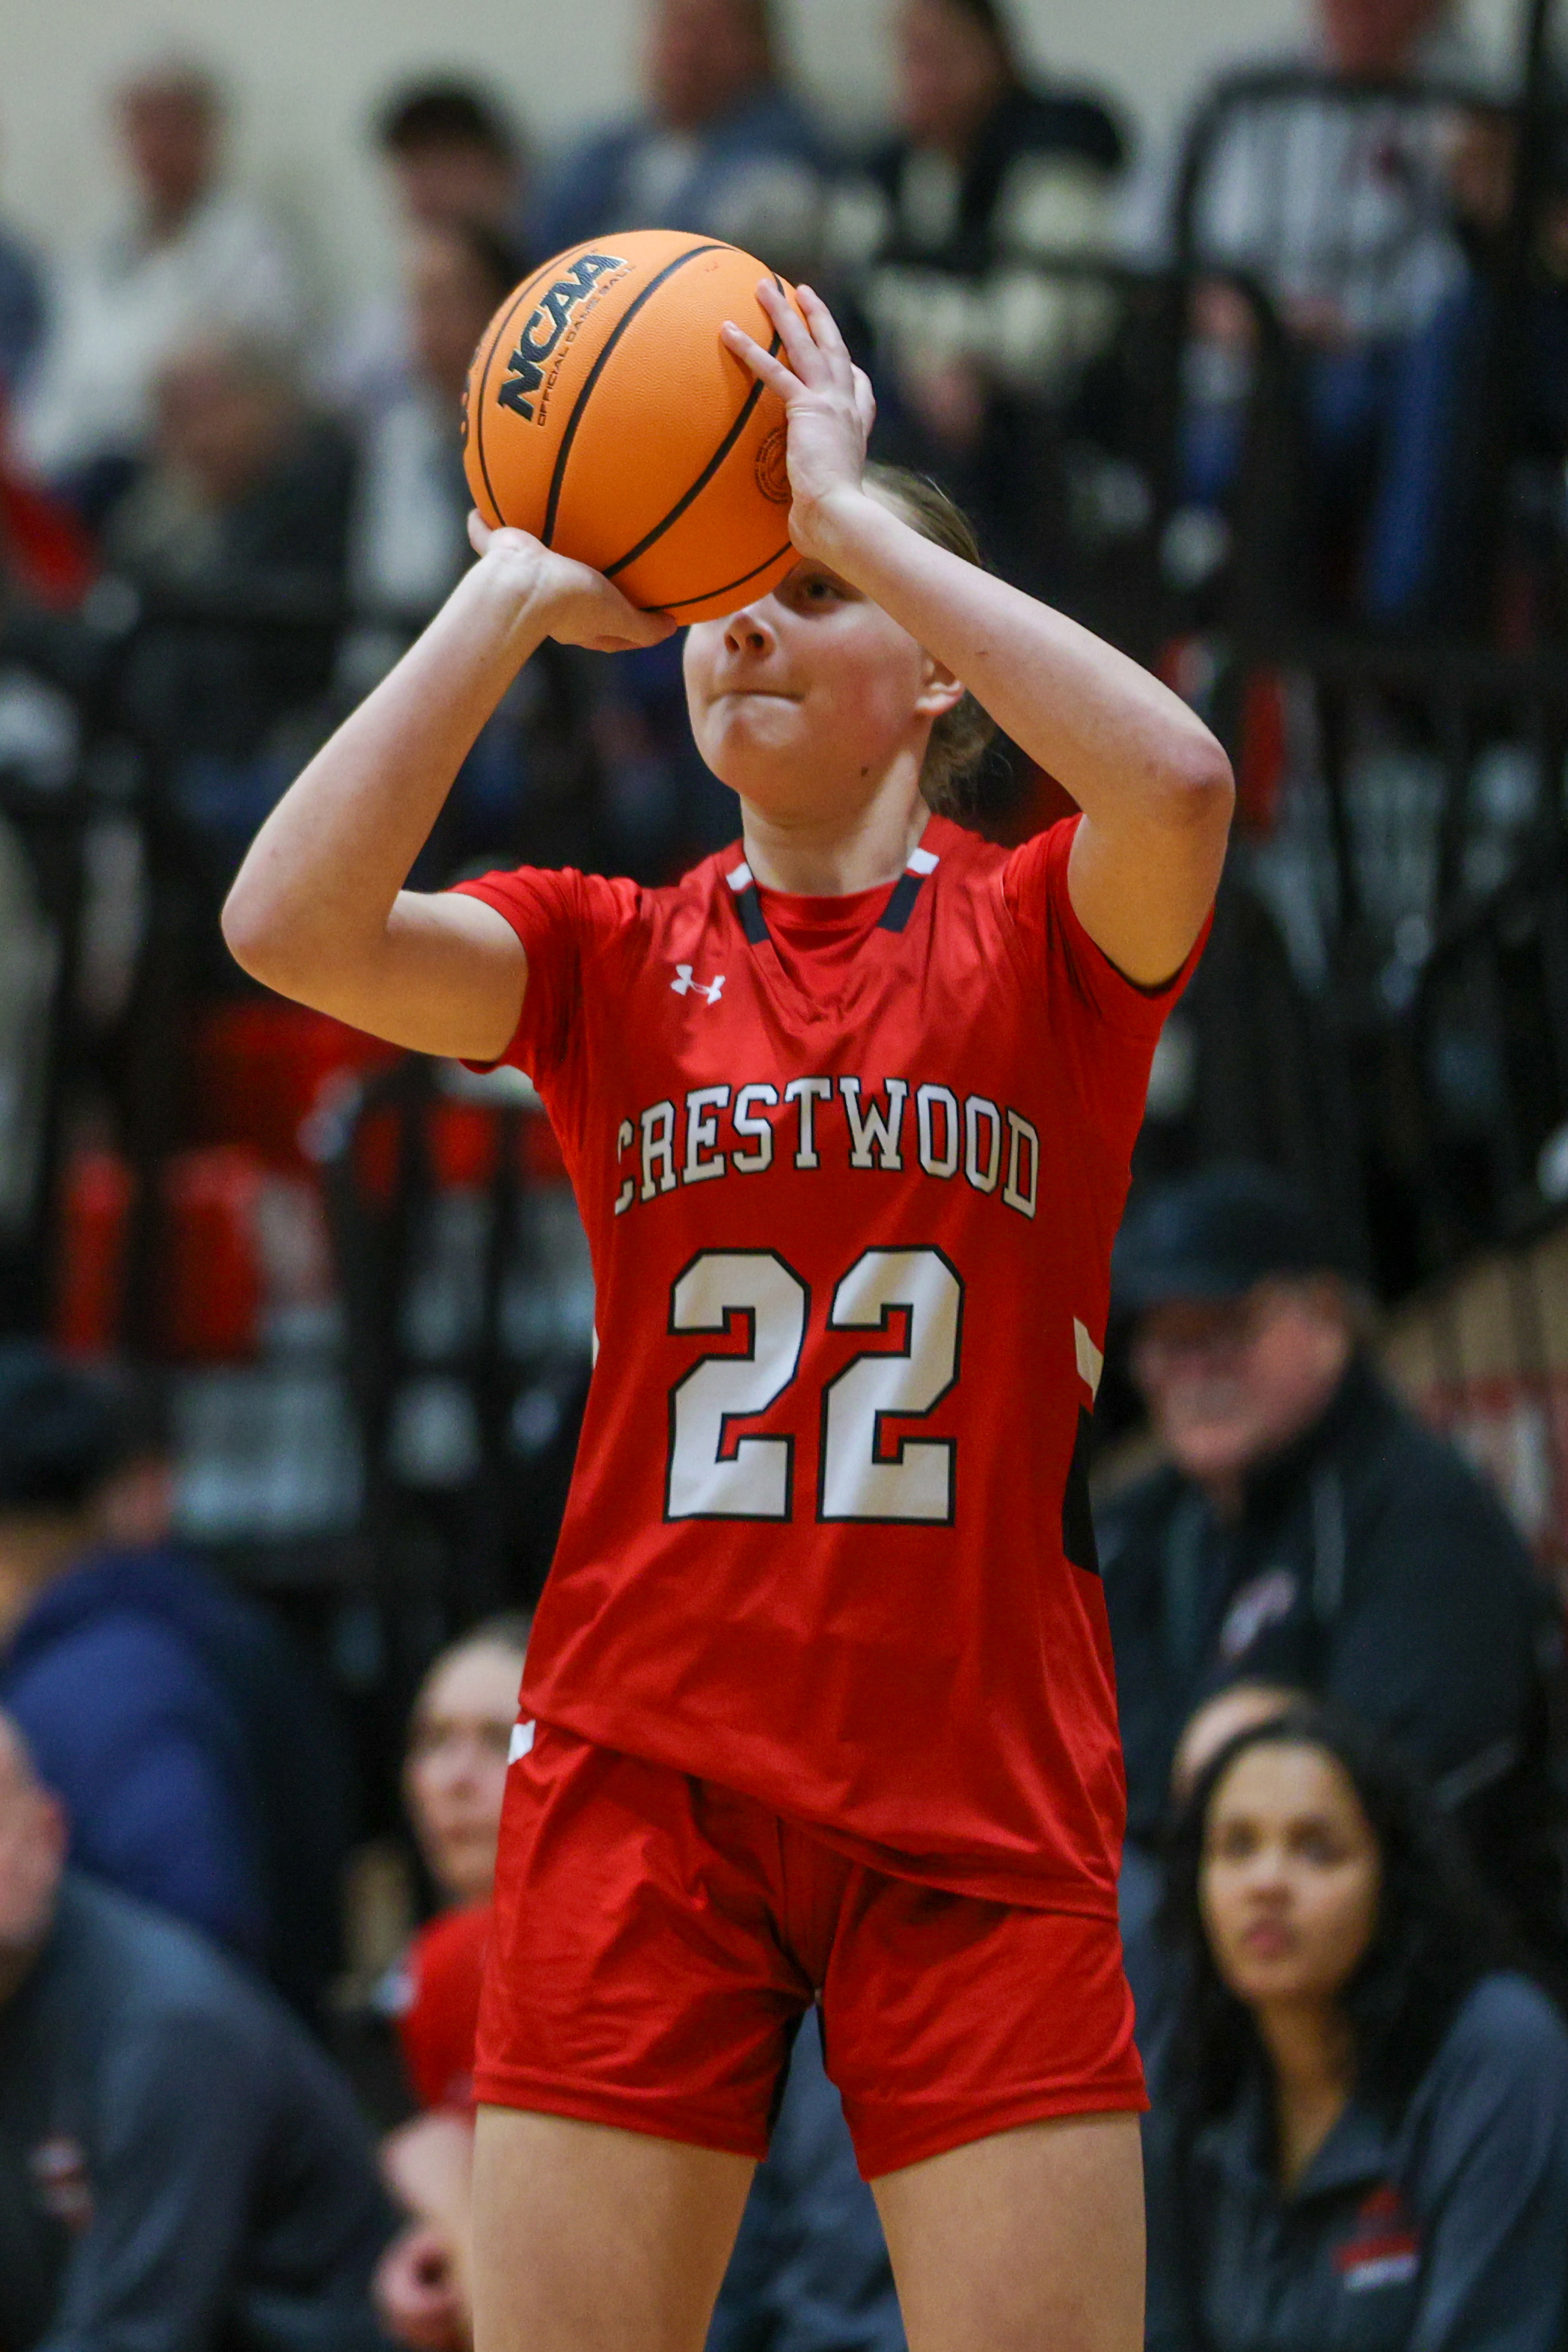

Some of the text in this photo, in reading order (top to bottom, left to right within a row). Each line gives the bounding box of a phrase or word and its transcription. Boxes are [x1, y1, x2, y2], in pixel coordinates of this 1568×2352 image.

[497, 253, 628, 422] NCAA
[537, 347, 570, 427] OFFICIAL
[663, 1244, 965, 1525] 22
